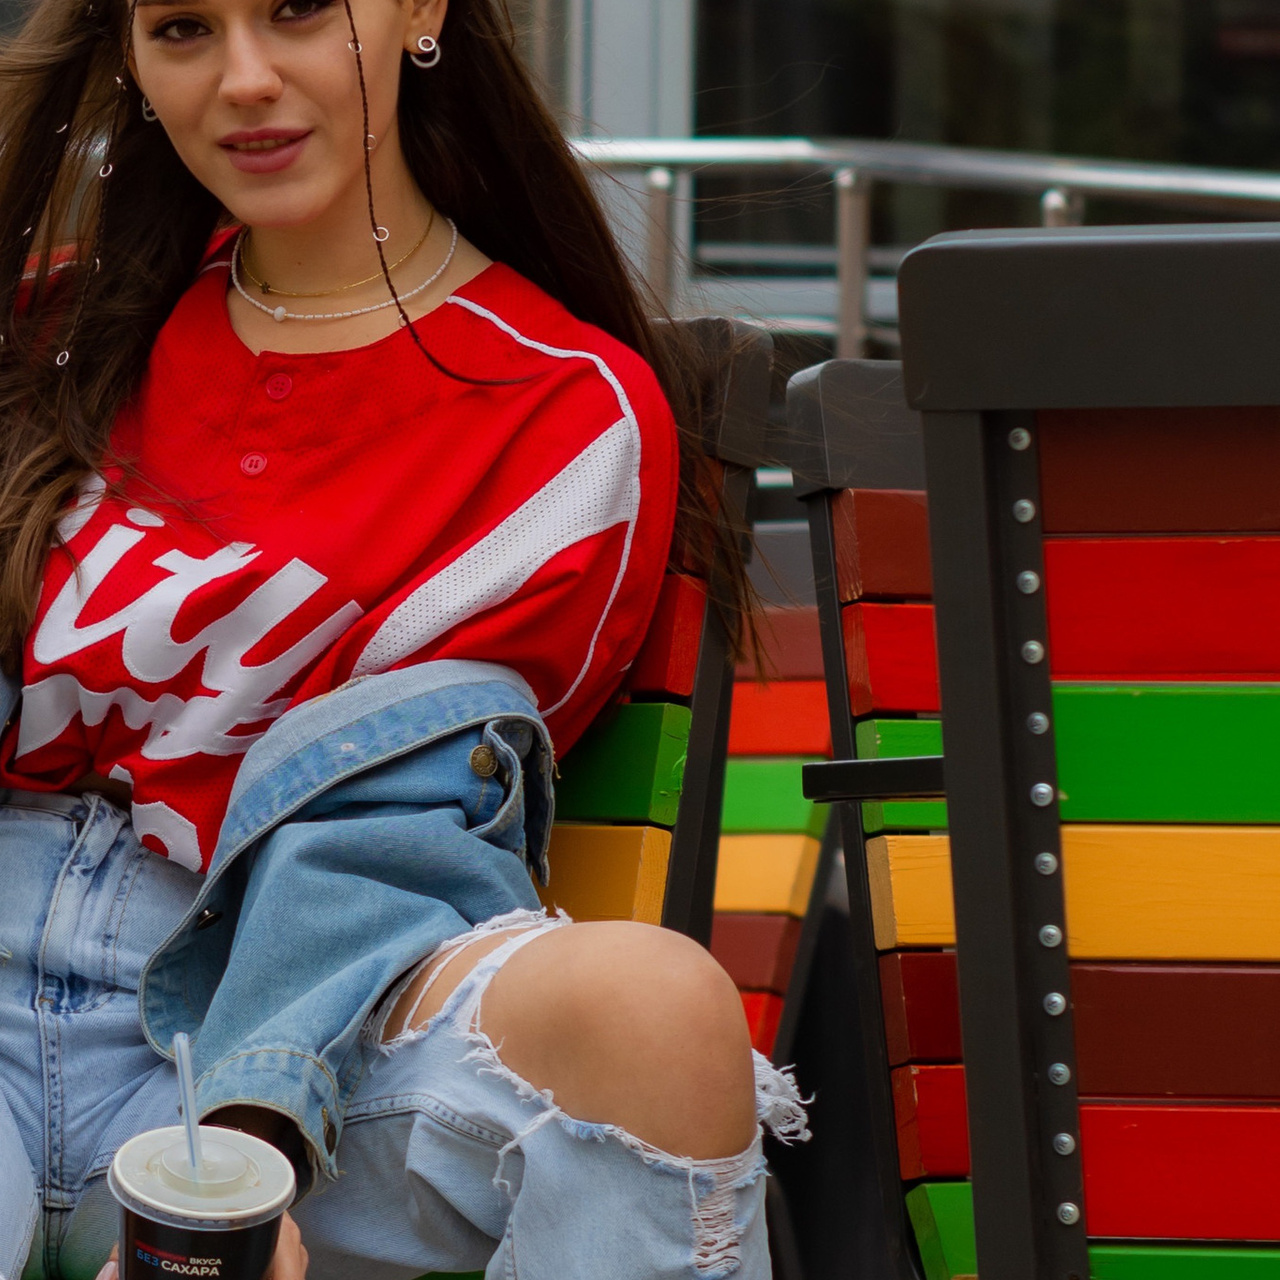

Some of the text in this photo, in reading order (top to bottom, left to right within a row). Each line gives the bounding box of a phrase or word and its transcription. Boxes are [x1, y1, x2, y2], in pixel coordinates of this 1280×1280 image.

[136, 1248, 159, 1267] БЕЗ
[161, 1260, 220, 1277] САХАРА
[189, 1257, 222, 1266] ВКУСА
